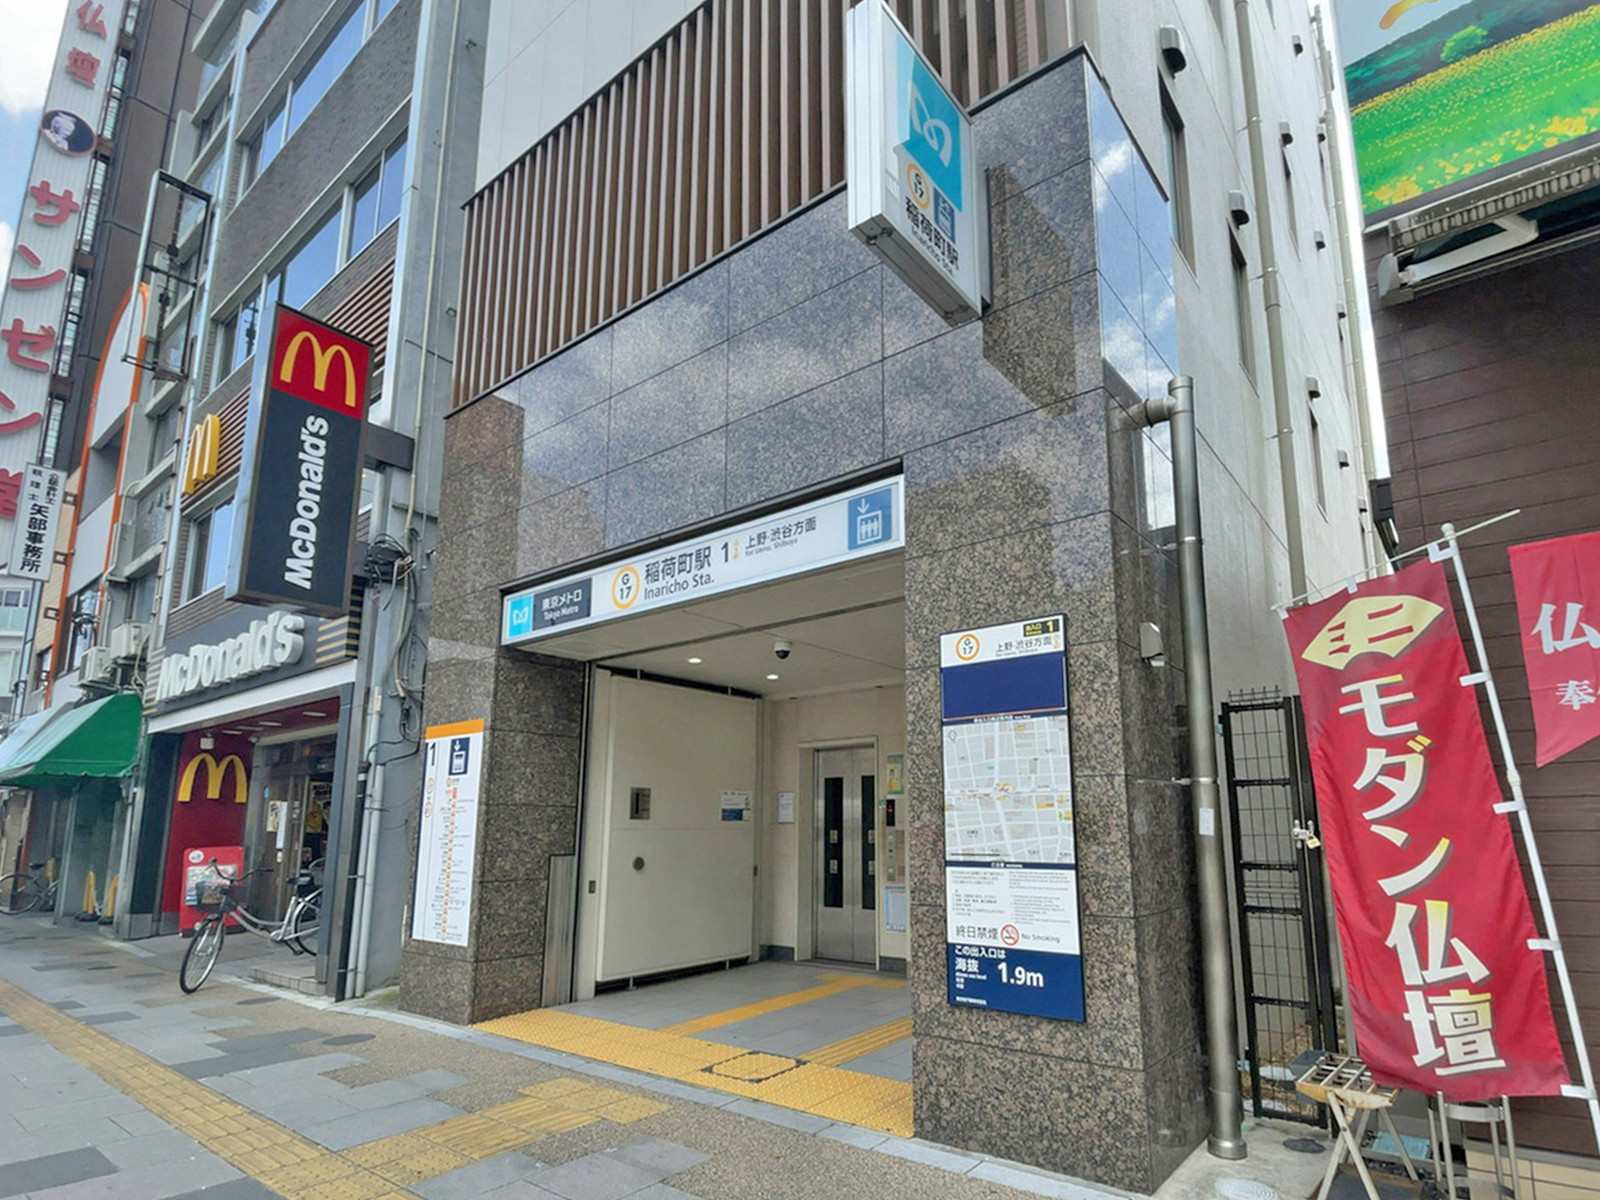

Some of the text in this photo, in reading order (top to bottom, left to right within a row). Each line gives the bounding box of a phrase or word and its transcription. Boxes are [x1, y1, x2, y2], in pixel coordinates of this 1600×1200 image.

[905, 196, 959, 270] 稲荷町駅
[284, 415, 329, 590] McDonald's
[20, 503, 49, 573] 矢部事務所
[721, 541, 729, 563] 1
[644, 546, 711, 584] 稲荷町駅
[621, 573, 630, 586] G
[644, 573, 715, 600] Inaricho Sta.
[541, 589, 582, 611] 東京メトロ
[619, 586, 632, 600] 17
[543, 604, 580, 622] Tokyo Metro
[1046, 620, 1055, 632] 1
[156, 611, 305, 702] McDonald's
[963, 647, 974, 655] 17
[429, 742, 437, 766] 1
[1339, 674, 1506, 1076] モダン仏壇
[956, 925, 999, 940] 終日禁煙
[1021, 933, 1060, 944] No Smoking
[955, 945, 1006, 959] この出入口は
[955, 957, 979, 973] 海抜
[997, 961, 1044, 988] 1.9m
